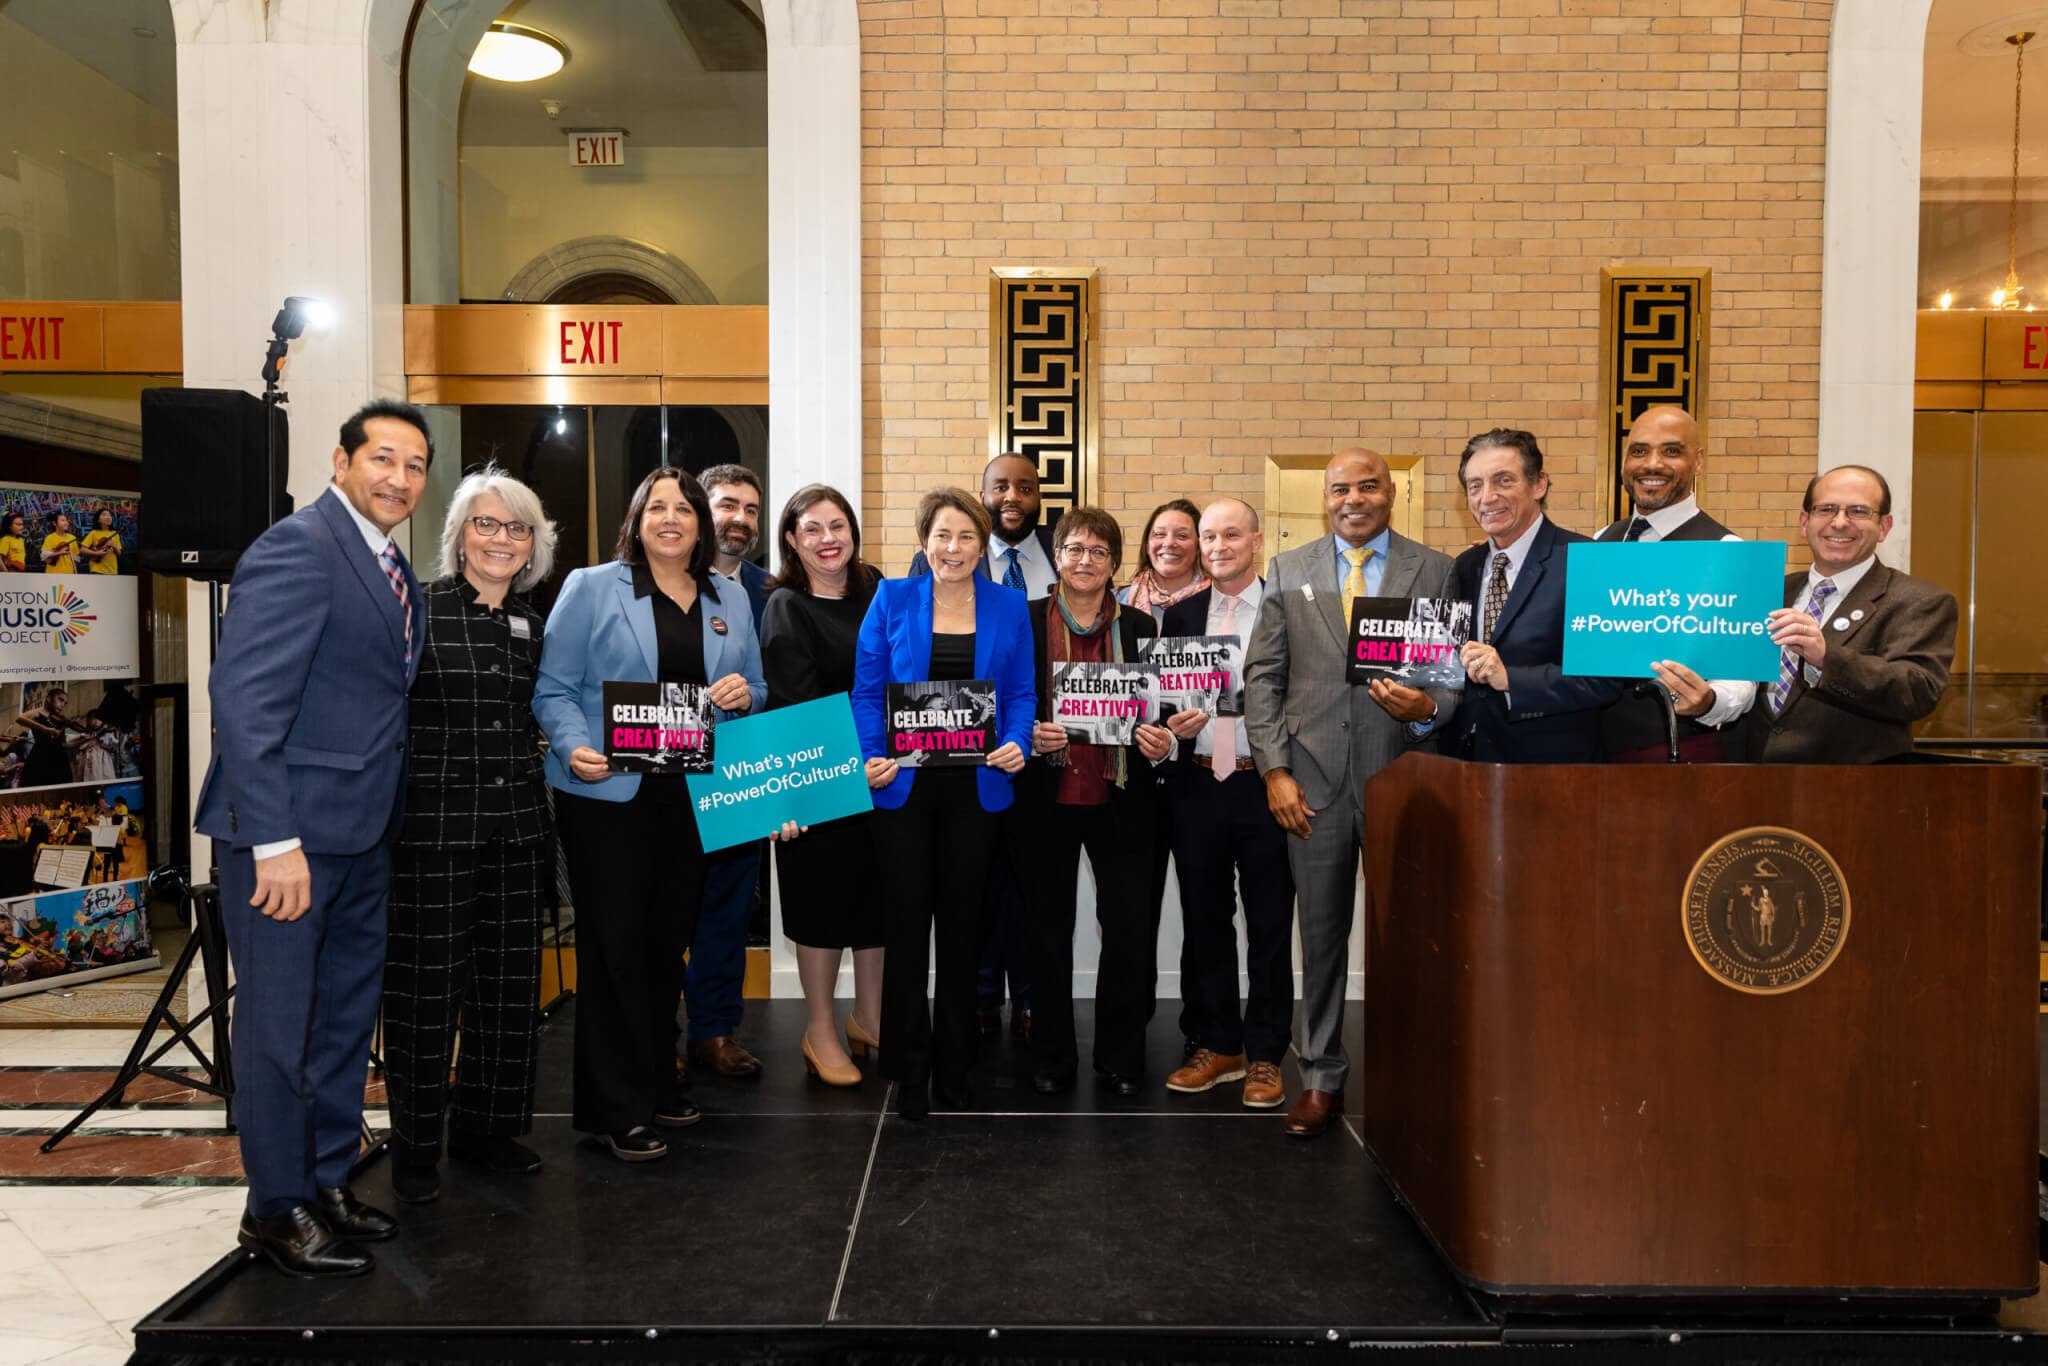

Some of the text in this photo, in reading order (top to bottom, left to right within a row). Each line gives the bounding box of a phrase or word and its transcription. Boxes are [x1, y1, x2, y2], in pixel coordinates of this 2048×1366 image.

[577, 137, 618, 164] EXIT
[1, 317, 64, 360] EXIT
[561, 321, 623, 364] EXIT
[1609, 588, 1737, 611] What's your
[0, 608, 64, 628] USIC
[1359, 618, 1444, 639] CELEBRATE
[1147, 651, 1218, 668] CELEBRATE
[1356, 640, 1454, 666] CREATIVITY
[1062, 678, 1136, 695] CELEBRATE
[1159, 671, 1231, 691] REATIVITY
[613, 704, 693, 724] CELEBRATE
[894, 709, 973, 728] CELEBRATE
[1061, 699, 1148, 718] CREATIVITY
[613, 727, 705, 750] CREATIVITY
[895, 730, 986, 751] CREATIVITY
[722, 744, 825, 781] What's your
[698, 757, 859, 811] #PowerOfCulture?
